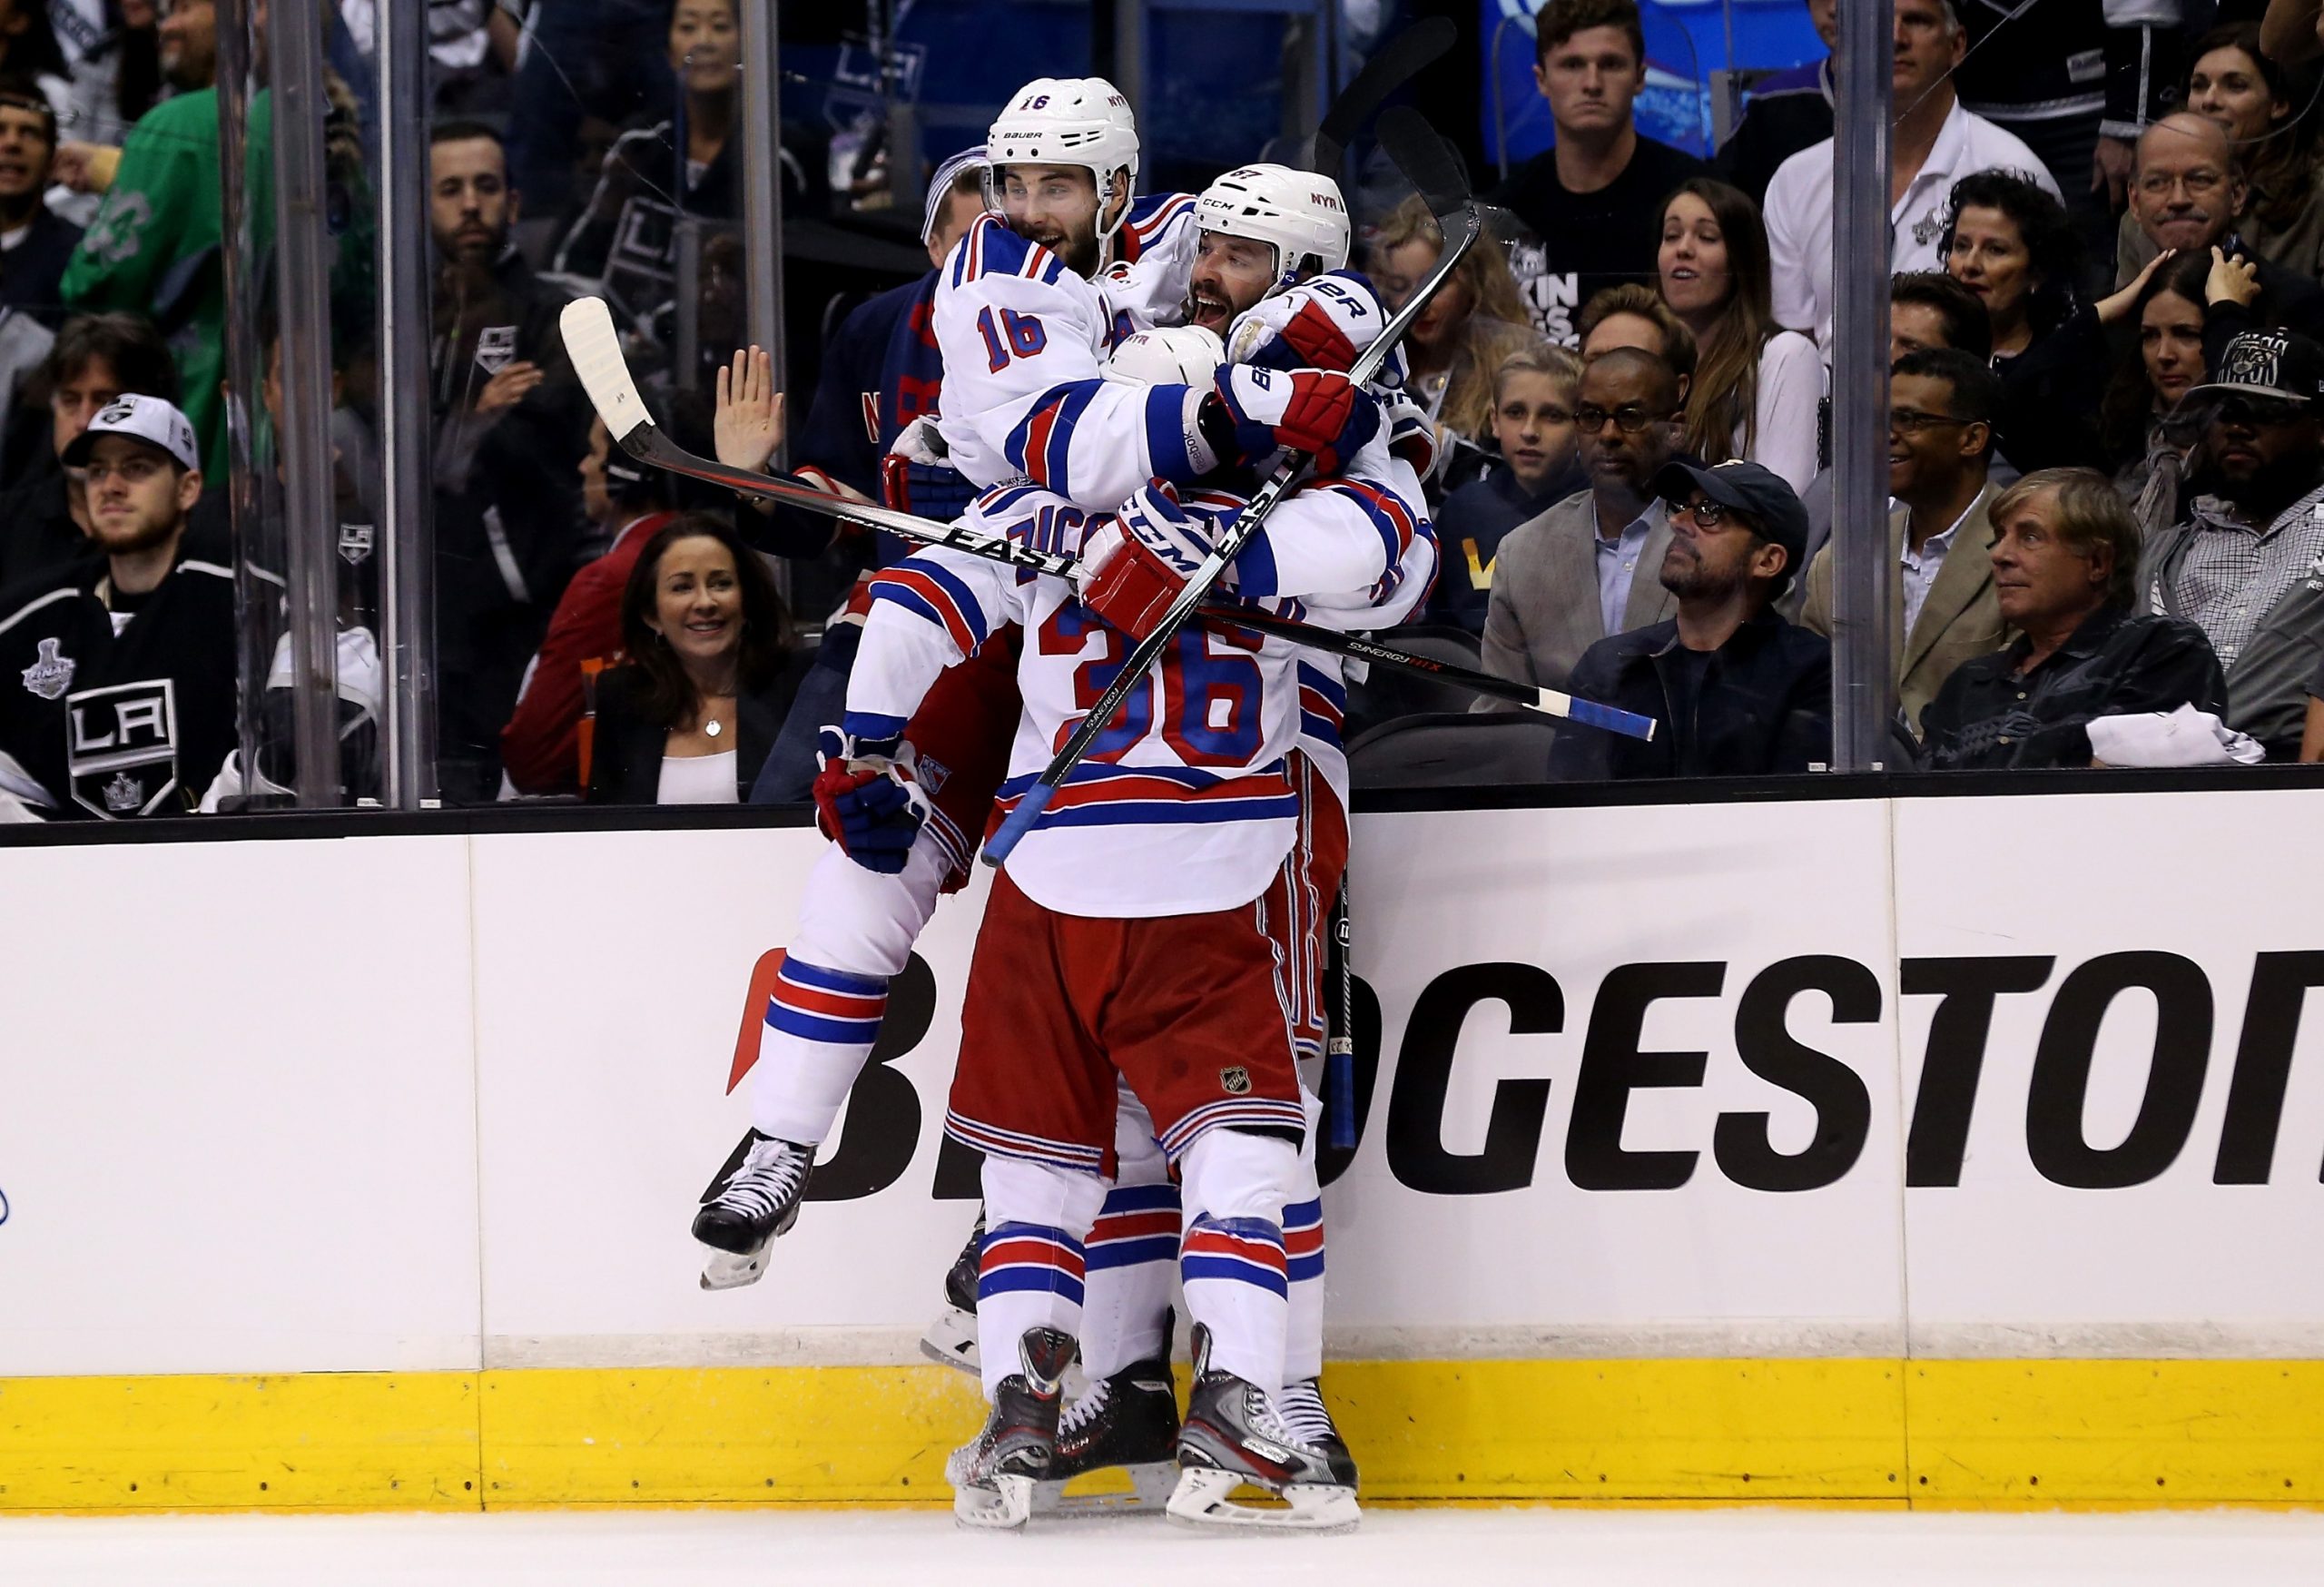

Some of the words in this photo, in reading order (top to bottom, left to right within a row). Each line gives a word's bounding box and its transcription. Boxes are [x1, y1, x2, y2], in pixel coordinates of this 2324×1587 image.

[1019, 94, 1050, 111] 16
[1202, 198, 1236, 211] CCM
[1310, 192, 1338, 211] NYR
[976, 305, 1048, 375] 16
[1183, 429, 1206, 470] Reebok
[1039, 595, 1264, 767] 36
[72, 697, 165, 752] LA
